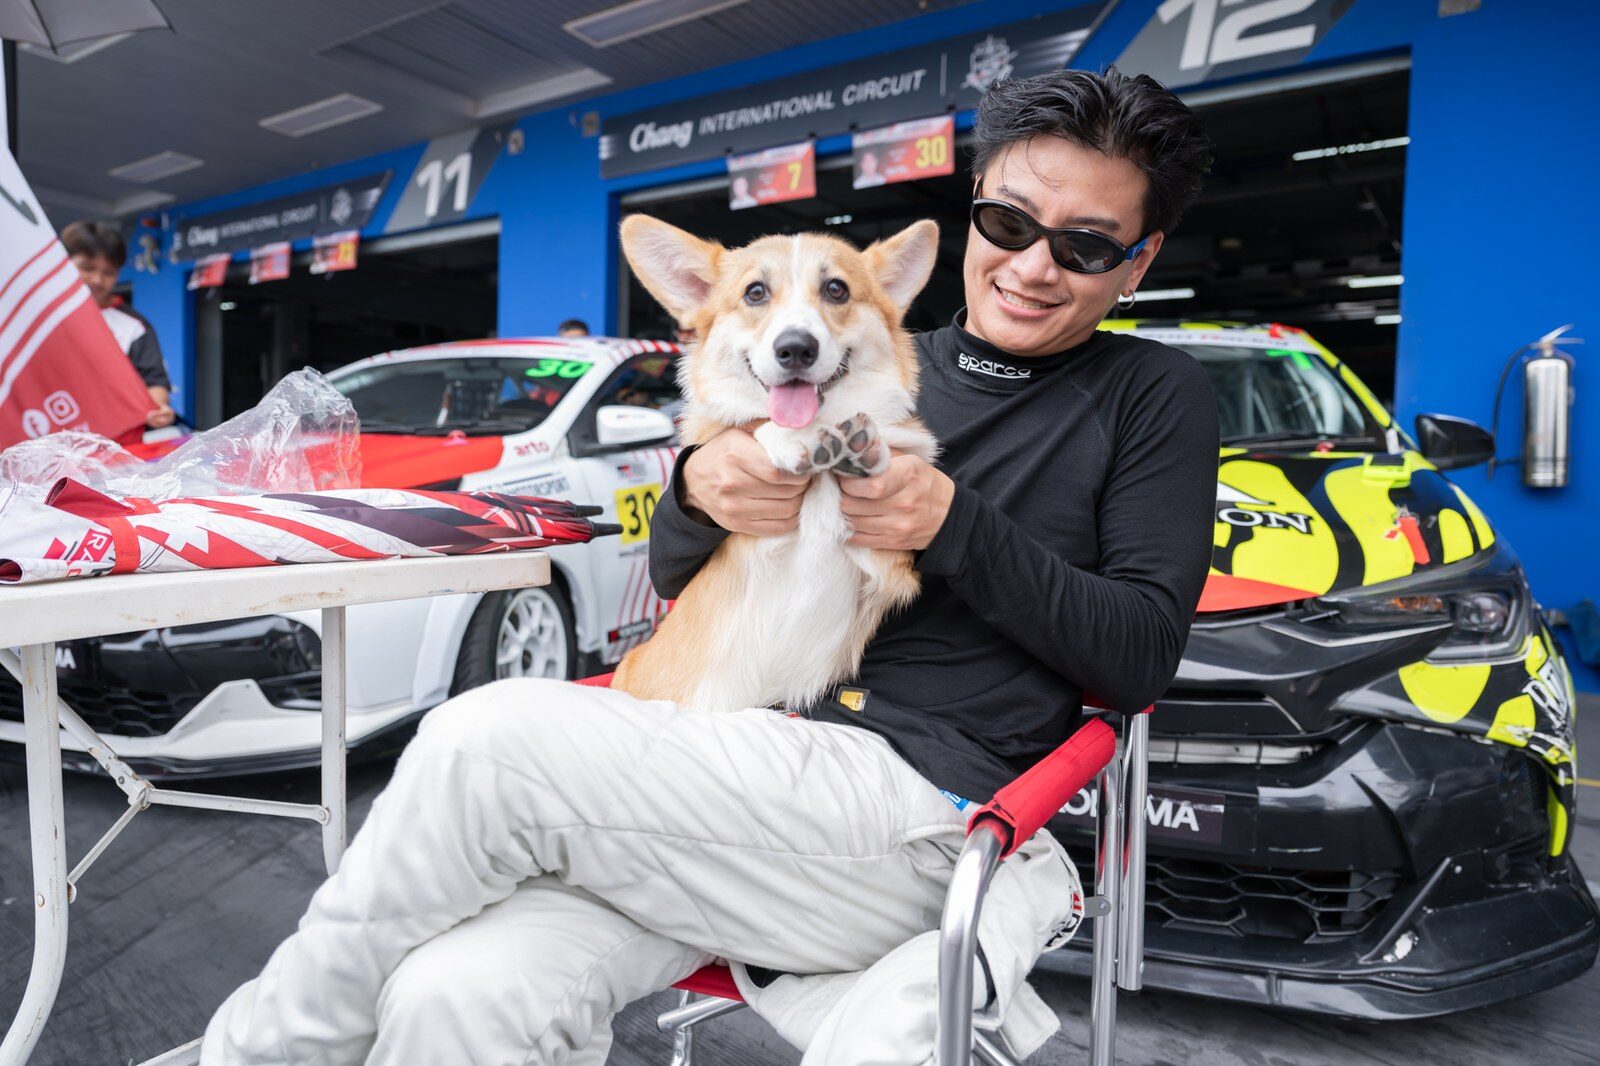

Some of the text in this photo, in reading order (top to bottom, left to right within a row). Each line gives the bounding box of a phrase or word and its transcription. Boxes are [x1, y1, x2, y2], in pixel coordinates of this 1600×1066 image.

[1156, 0, 1317, 71] 12
[629, 121, 693, 152] Chang
[698, 91, 836, 136] INTERNATIONAL
[841, 68, 927, 106] CIRCUIT
[915, 135, 948, 169] 30
[416, 152, 472, 218] 11
[787, 162, 802, 191] 7
[525, 358, 594, 378] 30
[958, 352, 1032, 377] sparco
[625, 490, 656, 536] 30
[1217, 507, 1313, 535] ON
